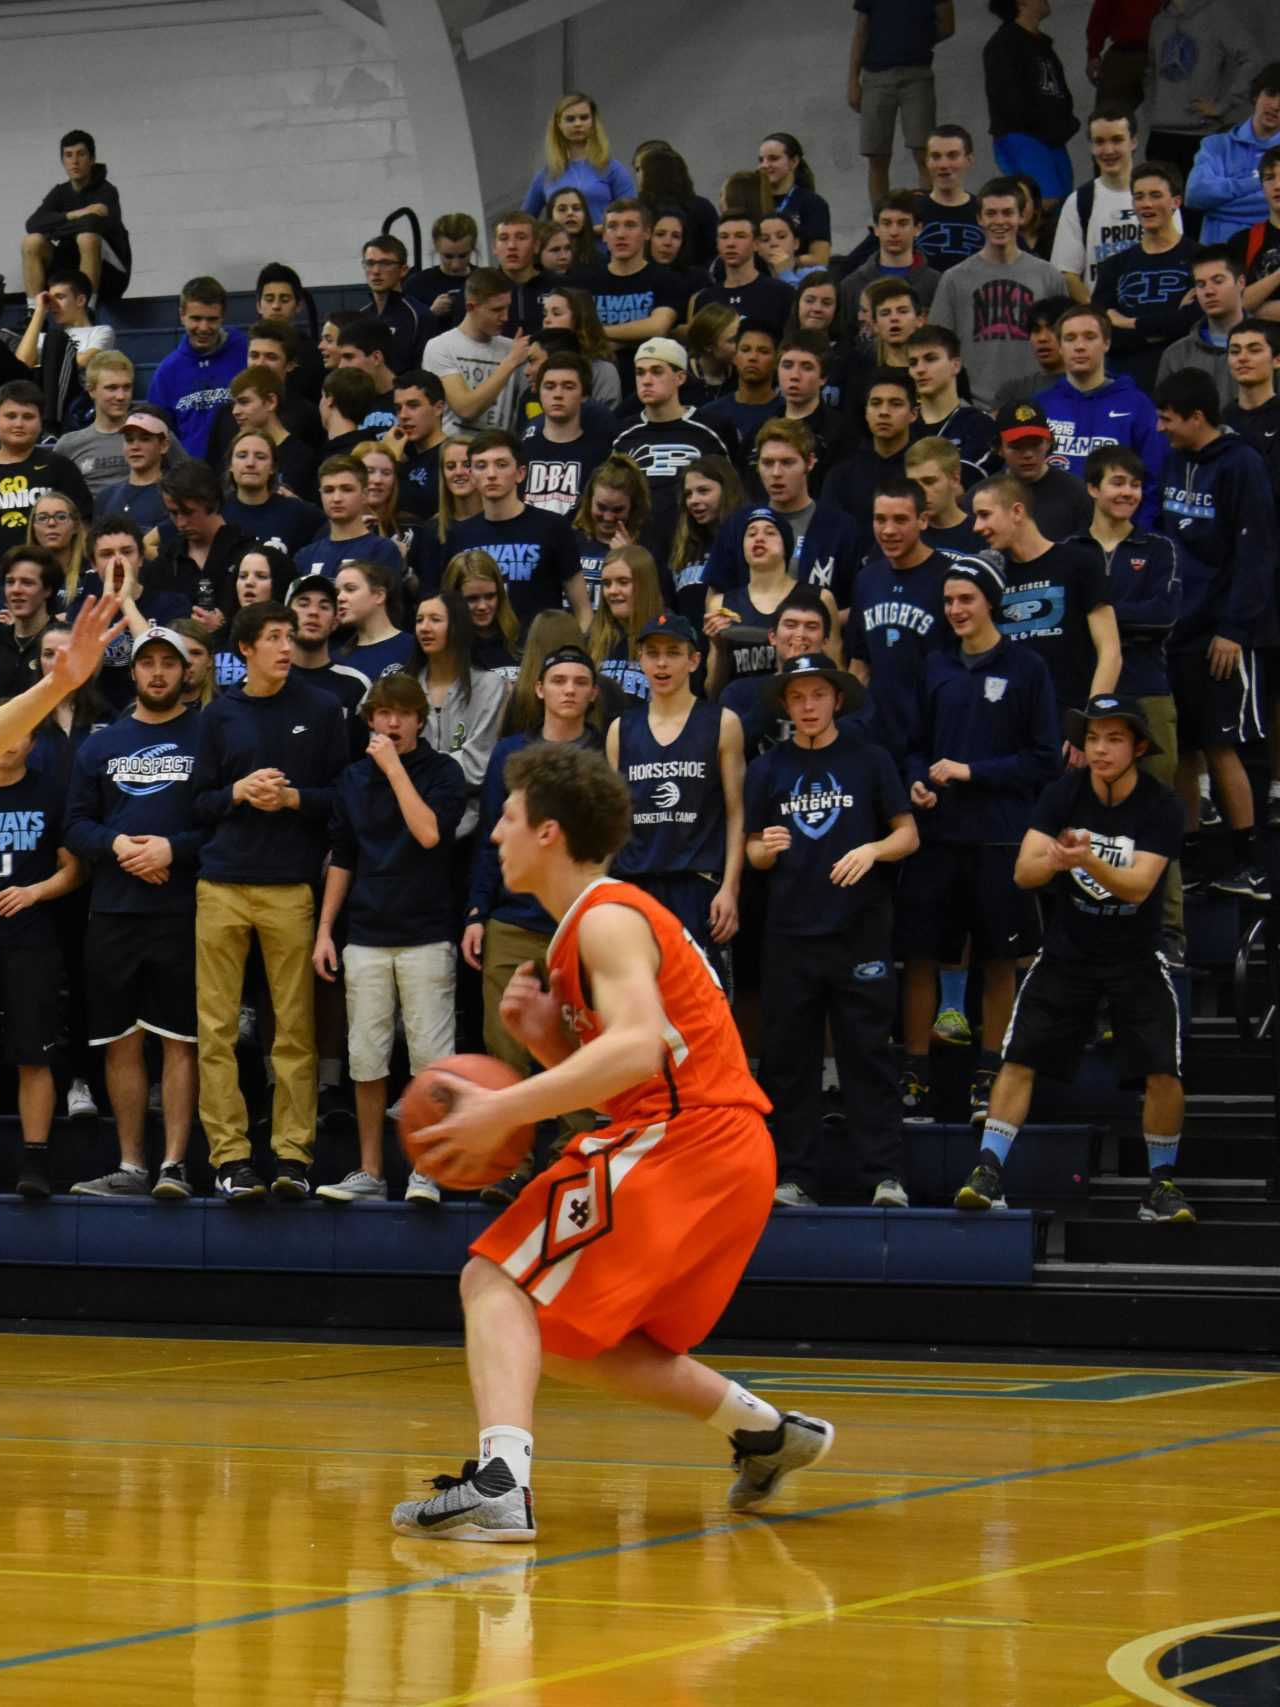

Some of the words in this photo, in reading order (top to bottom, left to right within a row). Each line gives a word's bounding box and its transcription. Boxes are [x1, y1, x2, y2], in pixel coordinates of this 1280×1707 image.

[596, 291, 655, 314] LWAYS
[0, 475, 29, 495] GO
[863, 602, 935, 636] KNIGHTS
[886, 628, 900, 648] P
[733, 645, 777, 674] PROSP
[106, 755, 195, 776] PROSPECT
[628, 761, 707, 781] HORSESHOE
[780, 794, 854, 816] KNIGHTS
[675, 811, 698, 824] CAMP
